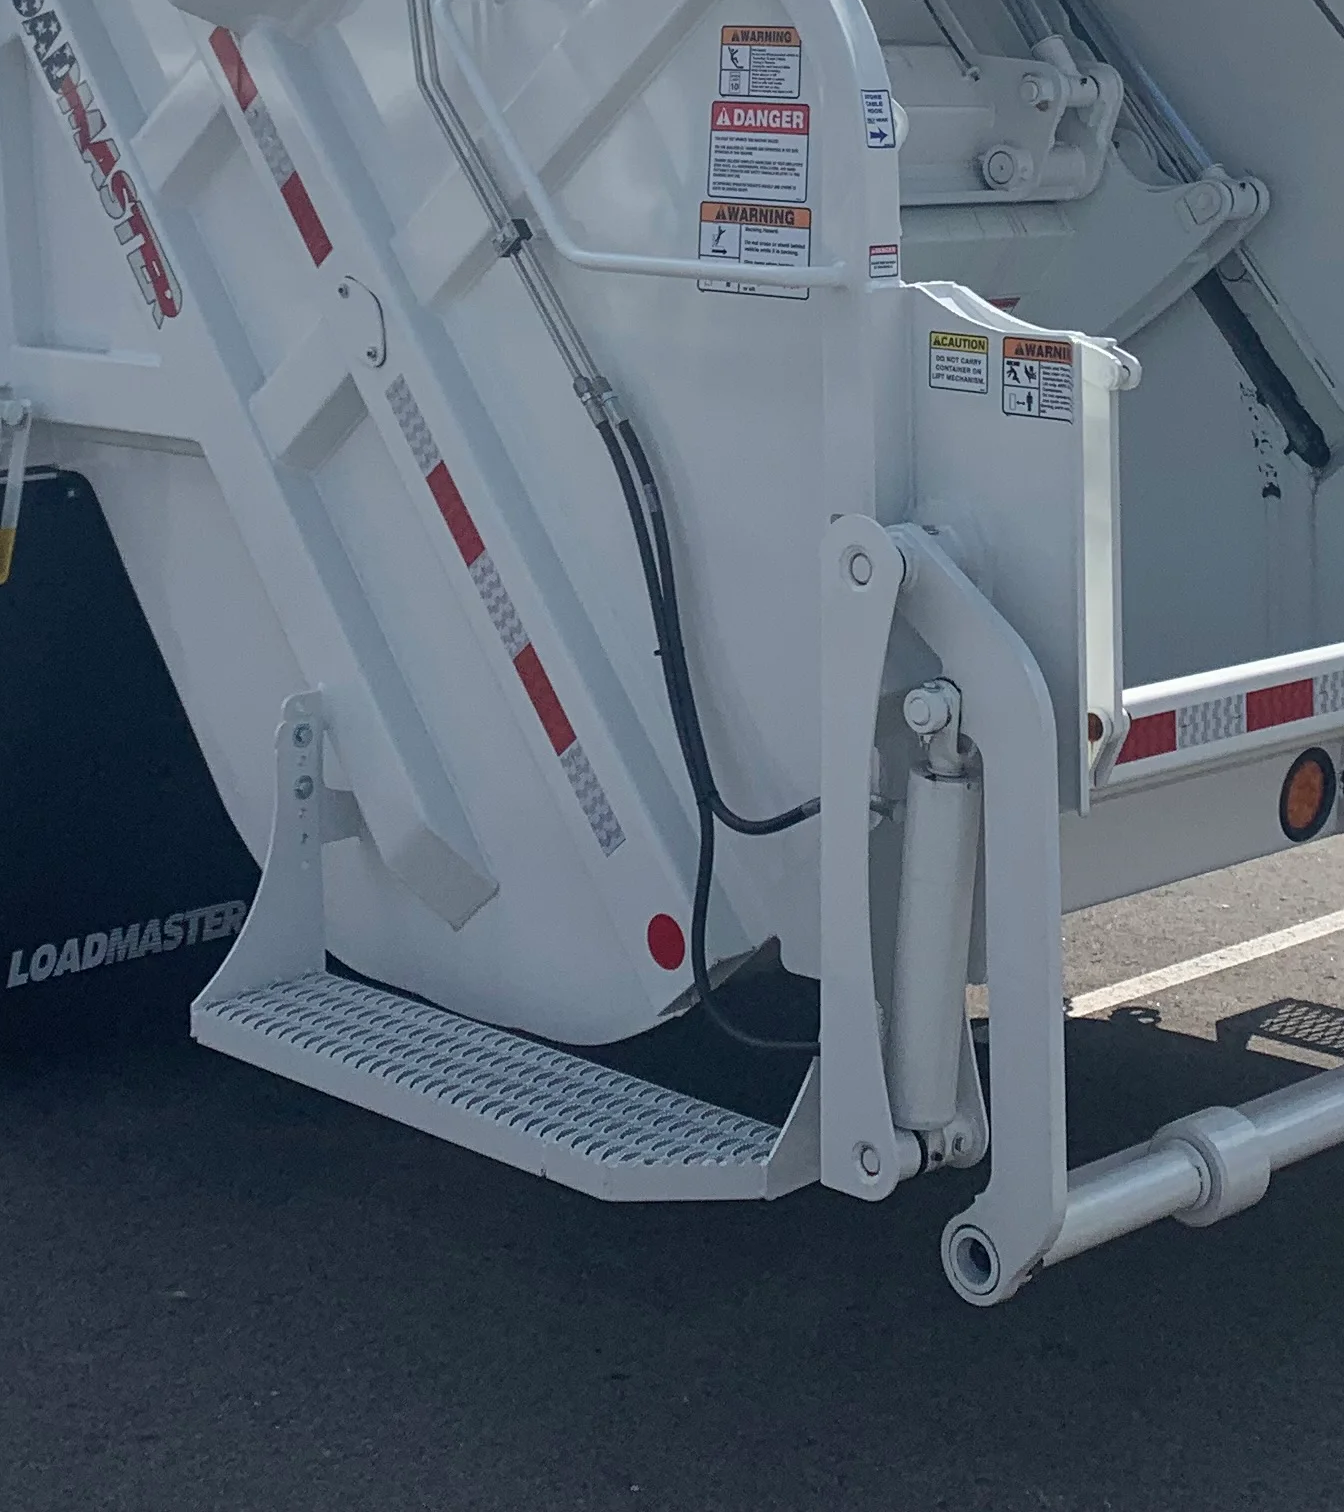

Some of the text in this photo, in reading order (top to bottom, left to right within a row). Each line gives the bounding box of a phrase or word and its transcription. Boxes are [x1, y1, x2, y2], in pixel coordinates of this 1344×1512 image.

[741, 30, 791, 43] WARNING
[733, 108, 804, 129] DANGER
[727, 206, 795, 225] WARNING
[941, 336, 986, 350] CAUTION
[935, 364, 971, 374] CONTAINER
[6, 900, 247, 988] LOADMASTER
